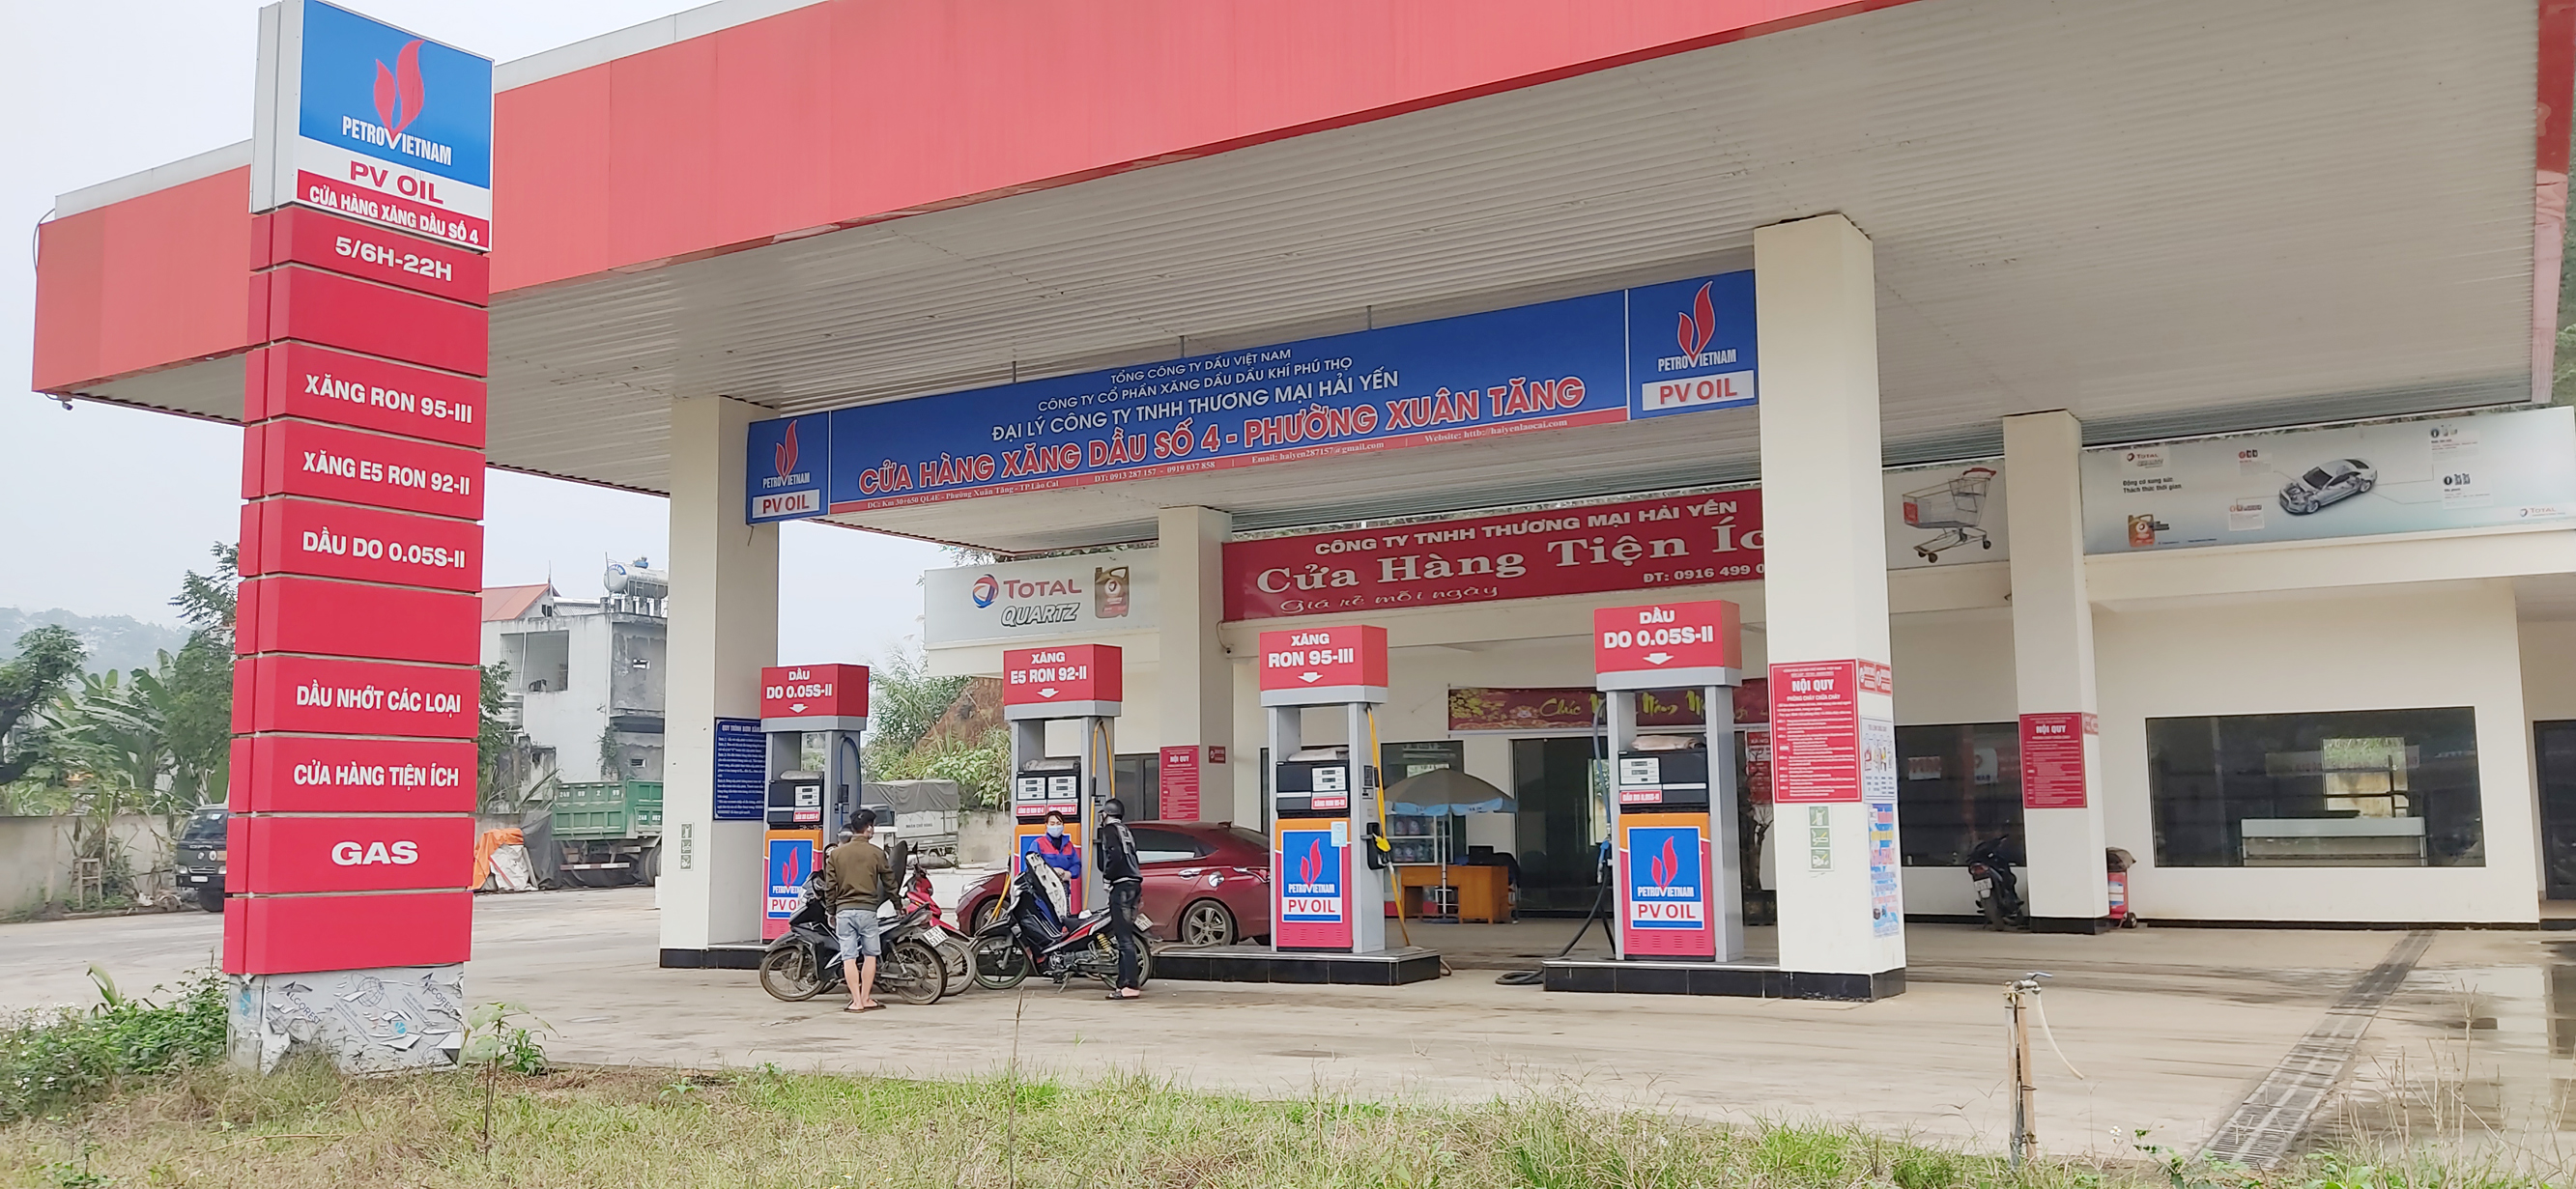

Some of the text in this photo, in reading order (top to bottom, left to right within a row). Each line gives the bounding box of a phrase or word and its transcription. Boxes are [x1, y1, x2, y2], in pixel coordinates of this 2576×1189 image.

[342, 116, 451, 166] PETROVIETNAM
[351, 160, 444, 204] PV OIL
[309, 184, 478, 244] CỬA HÀNG XĂNG DẦU SỐ 4
[335, 236, 451, 281] 5/6H-22H
[1111, 369, 1145, 383] TỔNG
[1147, 365, 1186, 379] CÔNG
[1188, 362, 1201, 372] TY
[1234, 353, 1257, 366] VIỆT
[1261, 349, 1291, 362] NAM
[1658, 349, 1736, 372] PETROVIETNAM
[1039, 357, 1352, 411] CÔNG TY CỔ PHẦN XĂNG DẦU DẦU KHÍ PHÚ THỌ
[1660, 378, 1737, 405] PV OIL
[304, 374, 472, 423] XĂNG RON 95-III
[991, 366, 1398, 442] ĐẠI LÝ CÔNG TY TNHH THƯƠNG MẠI HẢI YẾN
[859, 376, 1586, 495] CỬA HÀNG XĂNG DẦU SỐ 4 - PHƯỜNG XUÂN TĂNG
[1424, 432, 1462, 443] Website:
[1252, 453, 1277, 464] Email:
[302, 450, 470, 495] XĂNG E5 RON 92-II
[1110, 471, 1127, 480] 0913
[1167, 465, 1184, 473] 0919
[762, 494, 810, 514] PV OIL
[1315, 498, 1737, 555] CÔNG TY TNHH THƯƠNG MẠI HẢI YẾN
[302, 526, 465, 568] DẦU DO 0.05S-II
[1257, 516, 1764, 594] Cửa Hàng Tiện Íc
[1644, 572, 1669, 583] ĐT:
[1674, 567, 1714, 580] 0916
[1719, 564, 1750, 577] 499
[1004, 580, 1082, 600] TOTAL
[1280, 599, 1330, 613] Giá
[1432, 586, 1499, 600] ngày
[1001, 603, 1080, 627] QUARTZ
[1640, 607, 1674, 624] DẦU
[1291, 633, 1330, 646] XĂNG
[1604, 626, 1713, 648] DO 0.05S-II
[1031, 651, 1065, 665] XĂNG
[1269, 648, 1354, 667] RON 95-III
[788, 667, 810, 681] DẦU
[1011, 665, 1086, 685] E5 RON 92-II
[766, 684, 832, 699] DO 0.05S-II
[1791, 678, 1834, 694] NỘI QUY
[297, 679, 461, 718] DẦU NHỚT CÁC LOẠI
[1539, 697, 1582, 717] Chúc
[2036, 724, 2049, 734] NỘI
[294, 760, 458, 790] CỬA HÀNG TIỆN ÍCH
[331, 841, 417, 865] GAS
[772, 899, 787, 910] PV
[1288, 899, 1335, 913] PV OIL
[1638, 904, 1696, 919] PV OIL
